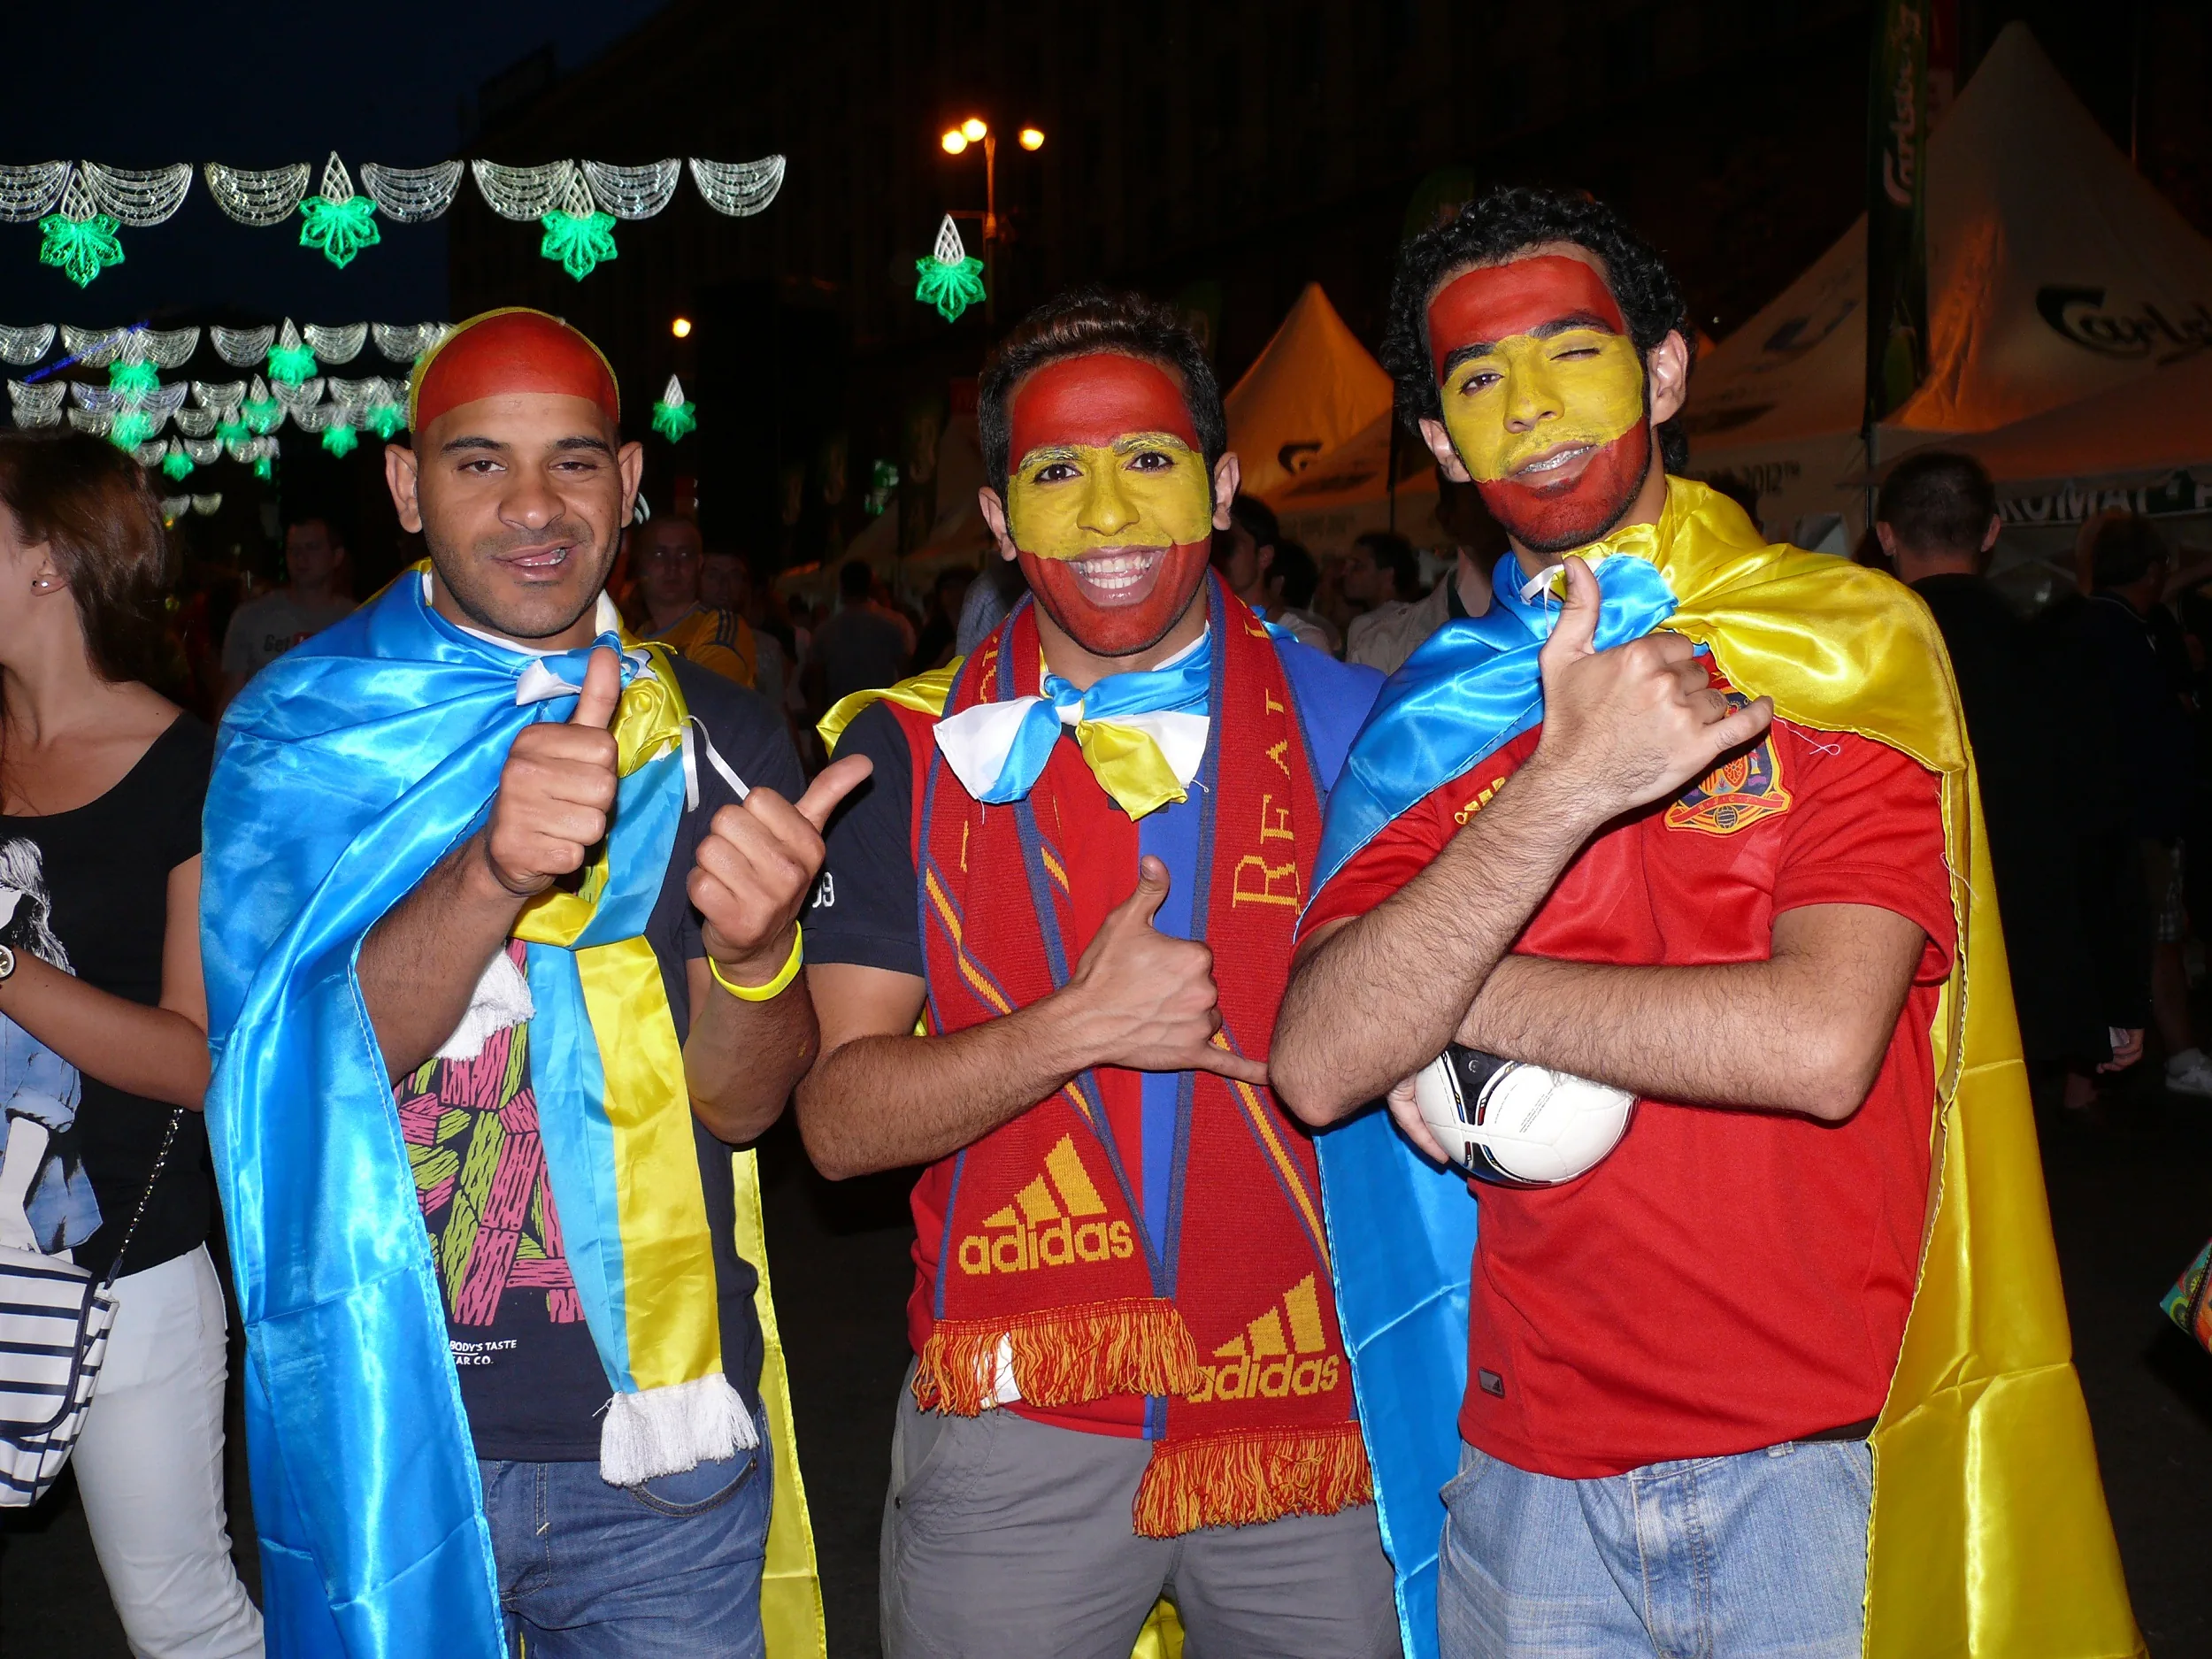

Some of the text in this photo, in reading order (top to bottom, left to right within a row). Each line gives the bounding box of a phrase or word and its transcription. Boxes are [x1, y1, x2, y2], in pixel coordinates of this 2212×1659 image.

[958, 1217, 1134, 1275] adidas
[485, 1339, 517, 1351] TASTE
[473, 1356, 495, 1365] CO.
